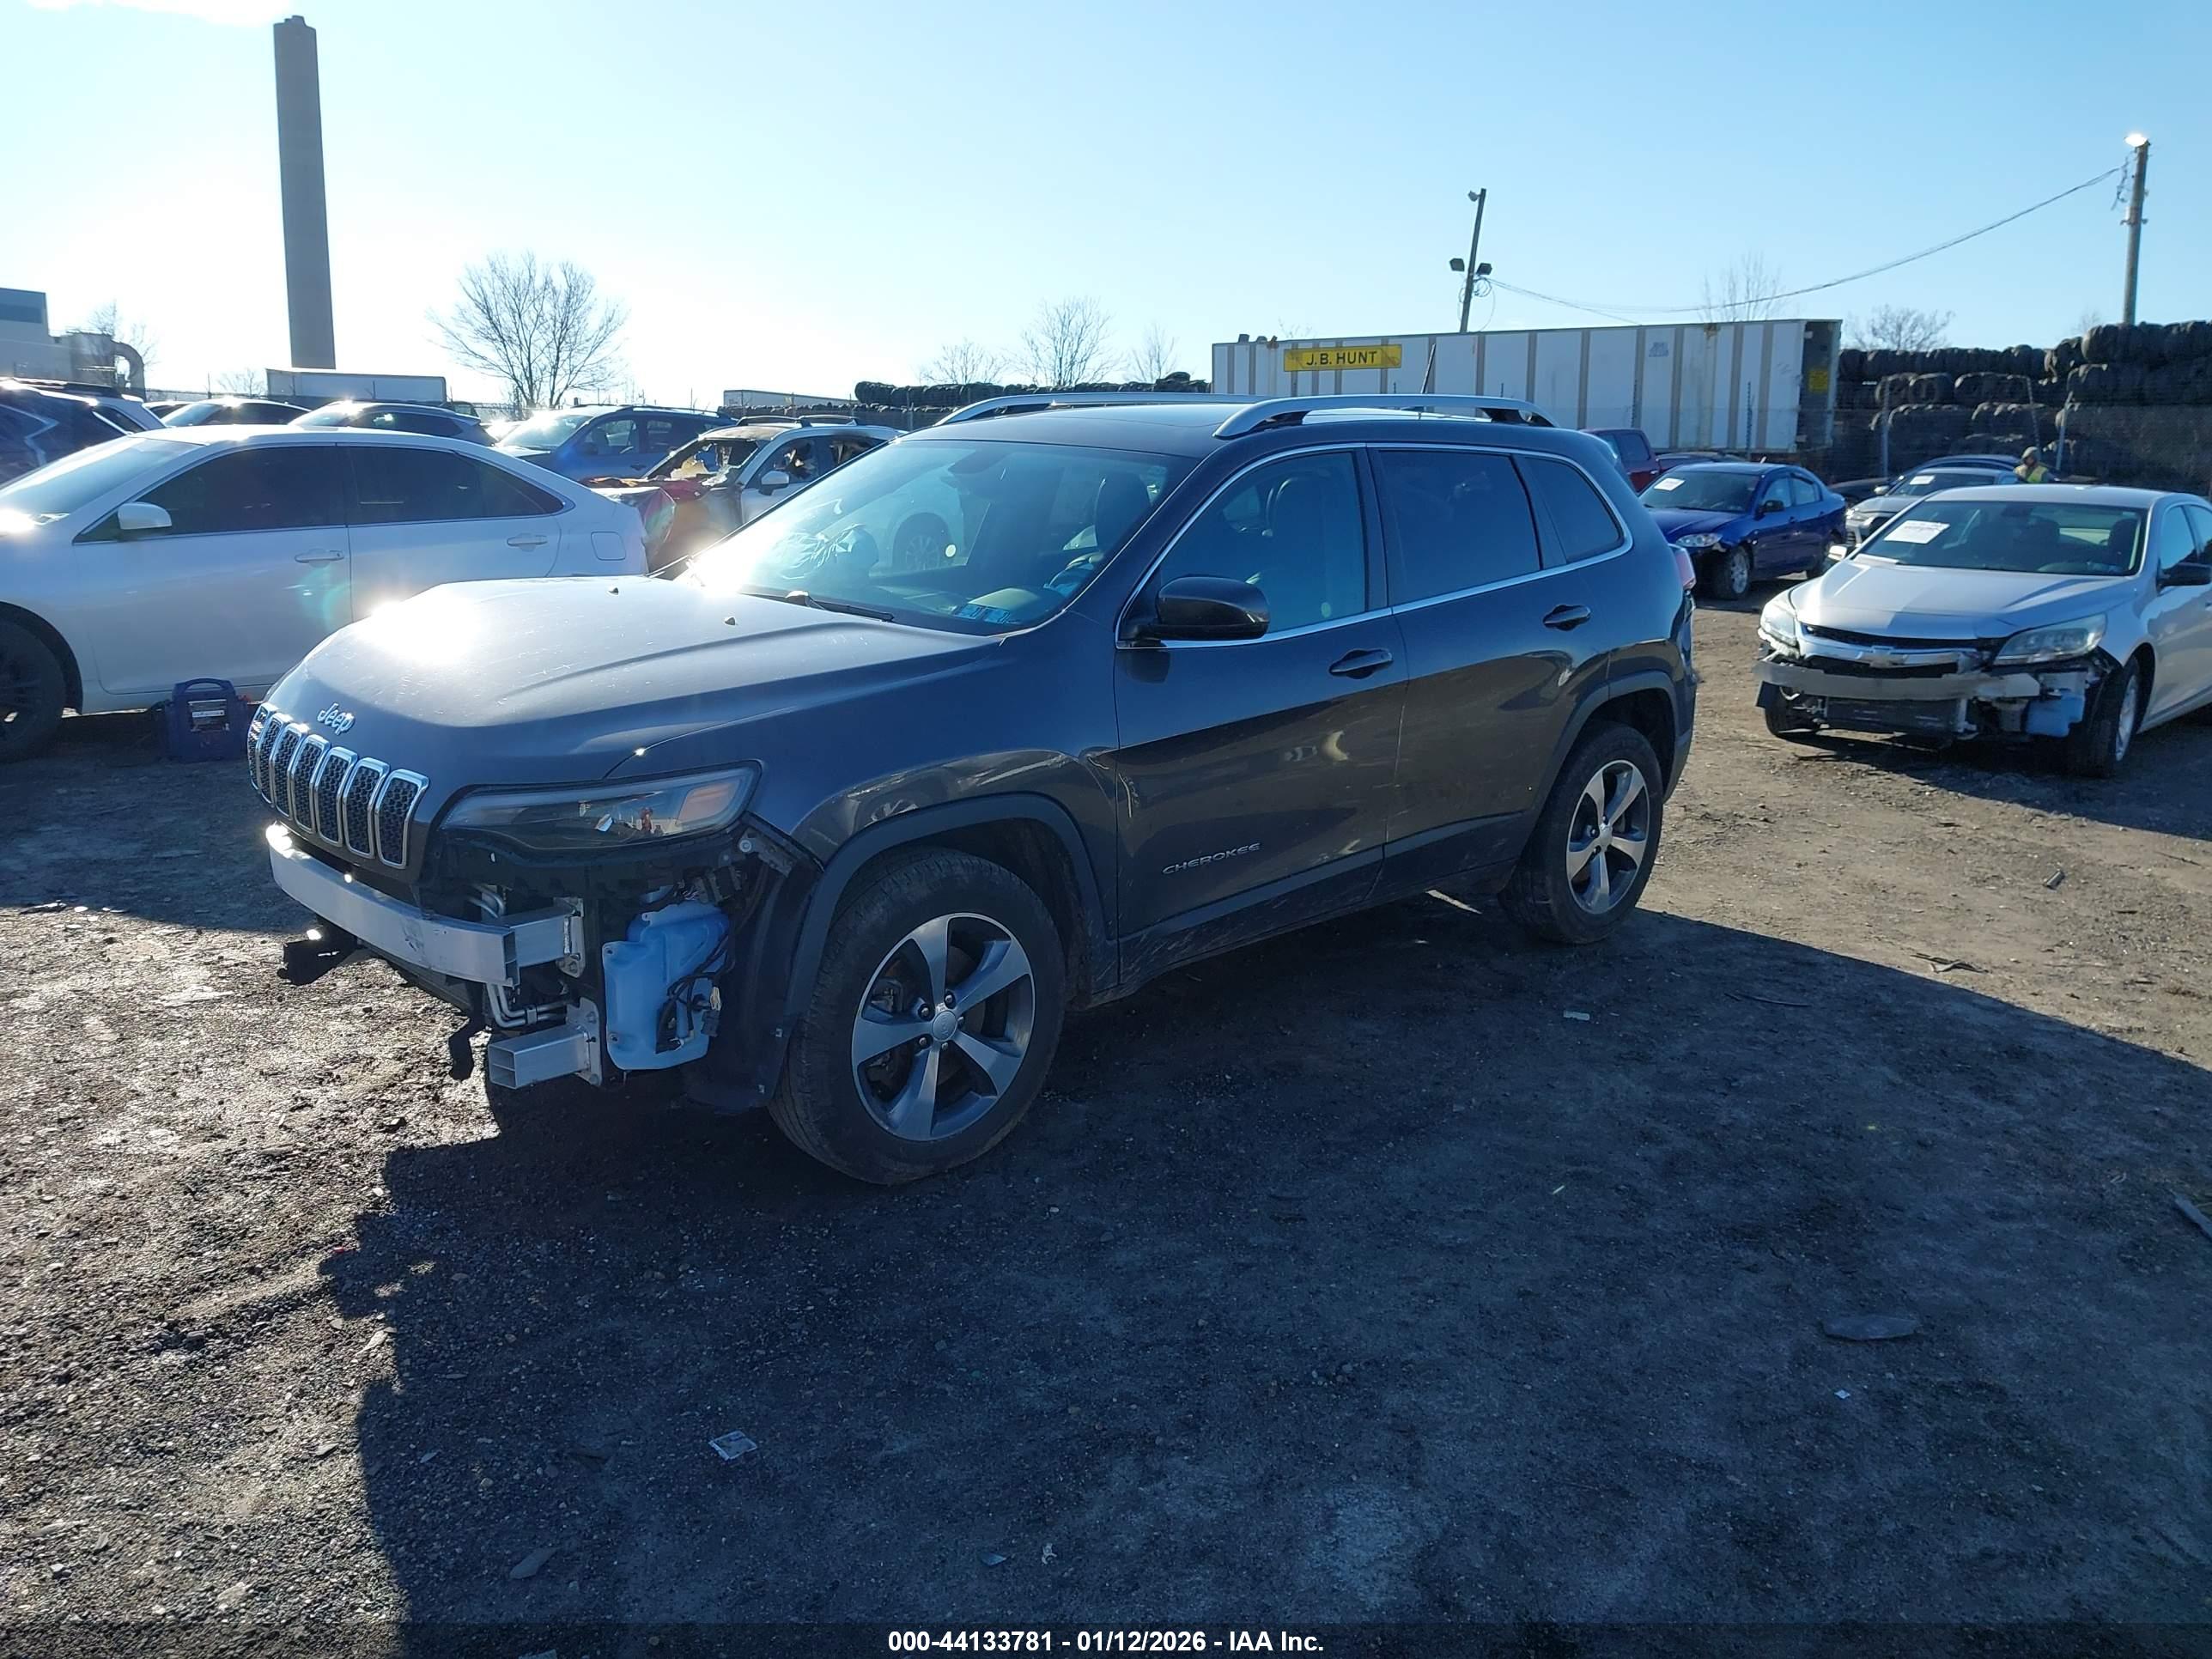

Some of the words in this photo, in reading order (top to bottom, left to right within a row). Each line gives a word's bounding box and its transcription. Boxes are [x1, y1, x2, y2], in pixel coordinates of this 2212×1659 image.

[1336, 350, 1377, 364] HUNT
[317, 702, 355, 736] Jeep
[1162, 842, 1261, 874] CHEROKEE
